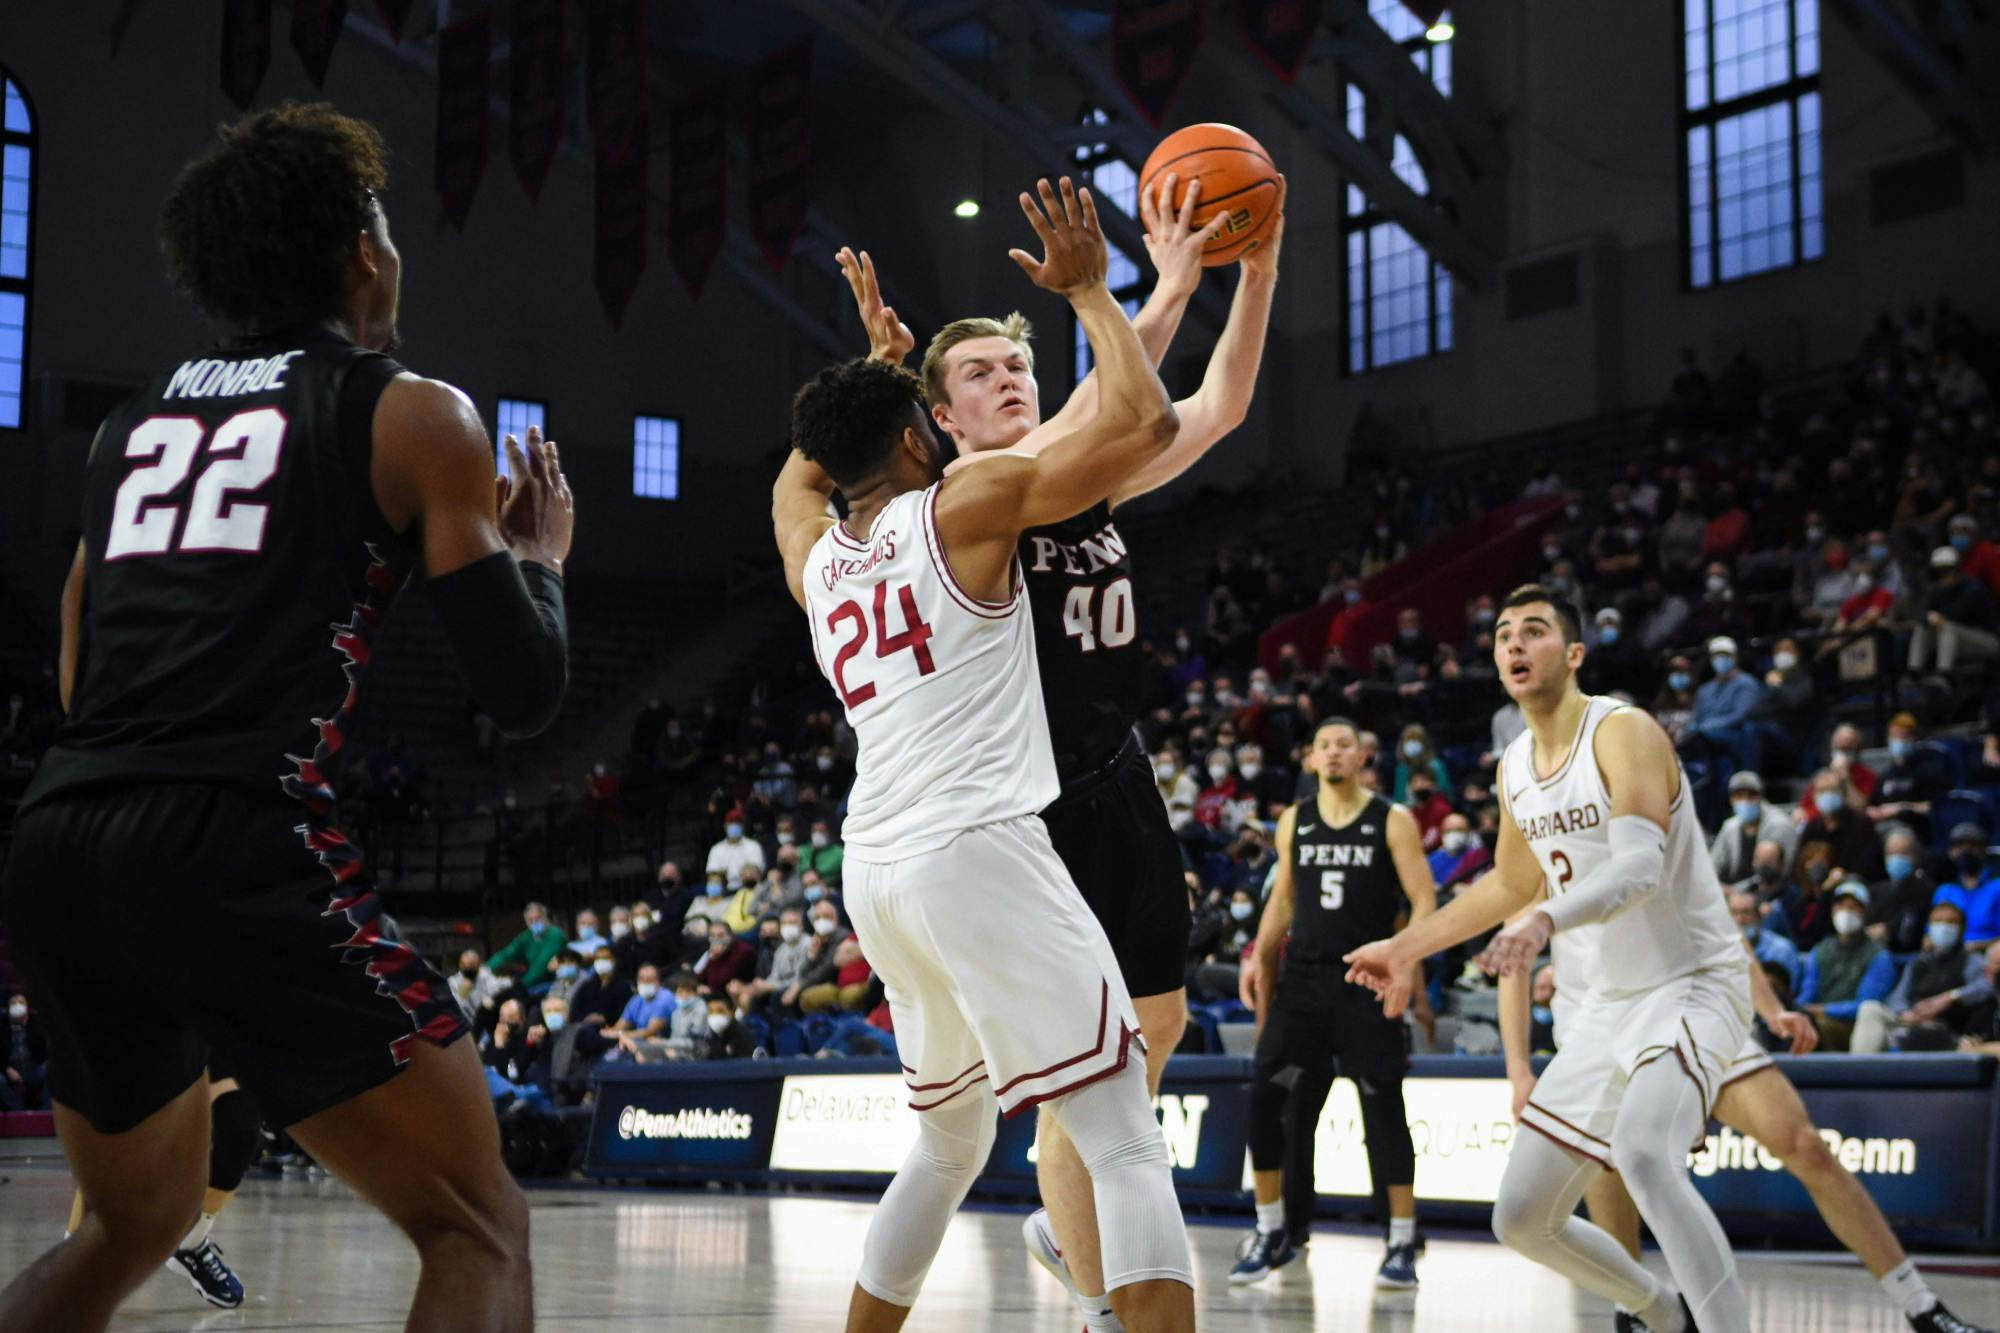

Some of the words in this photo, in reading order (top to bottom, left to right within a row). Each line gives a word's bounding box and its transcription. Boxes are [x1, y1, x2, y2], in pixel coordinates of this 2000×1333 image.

[162, 349, 305, 399] MONROE
[104, 405, 288, 561] 22
[821, 529, 896, 592] CATCHINGS
[1031, 522, 1128, 575] PENN
[1062, 577, 1136, 652] 40
[827, 579, 936, 711] 24
[1298, 844, 1374, 867] PENN
[1320, 870, 1345, 910] 5
[618, 1104, 752, 1140] @PennAthletics
[785, 1087, 897, 1122] Delaware
